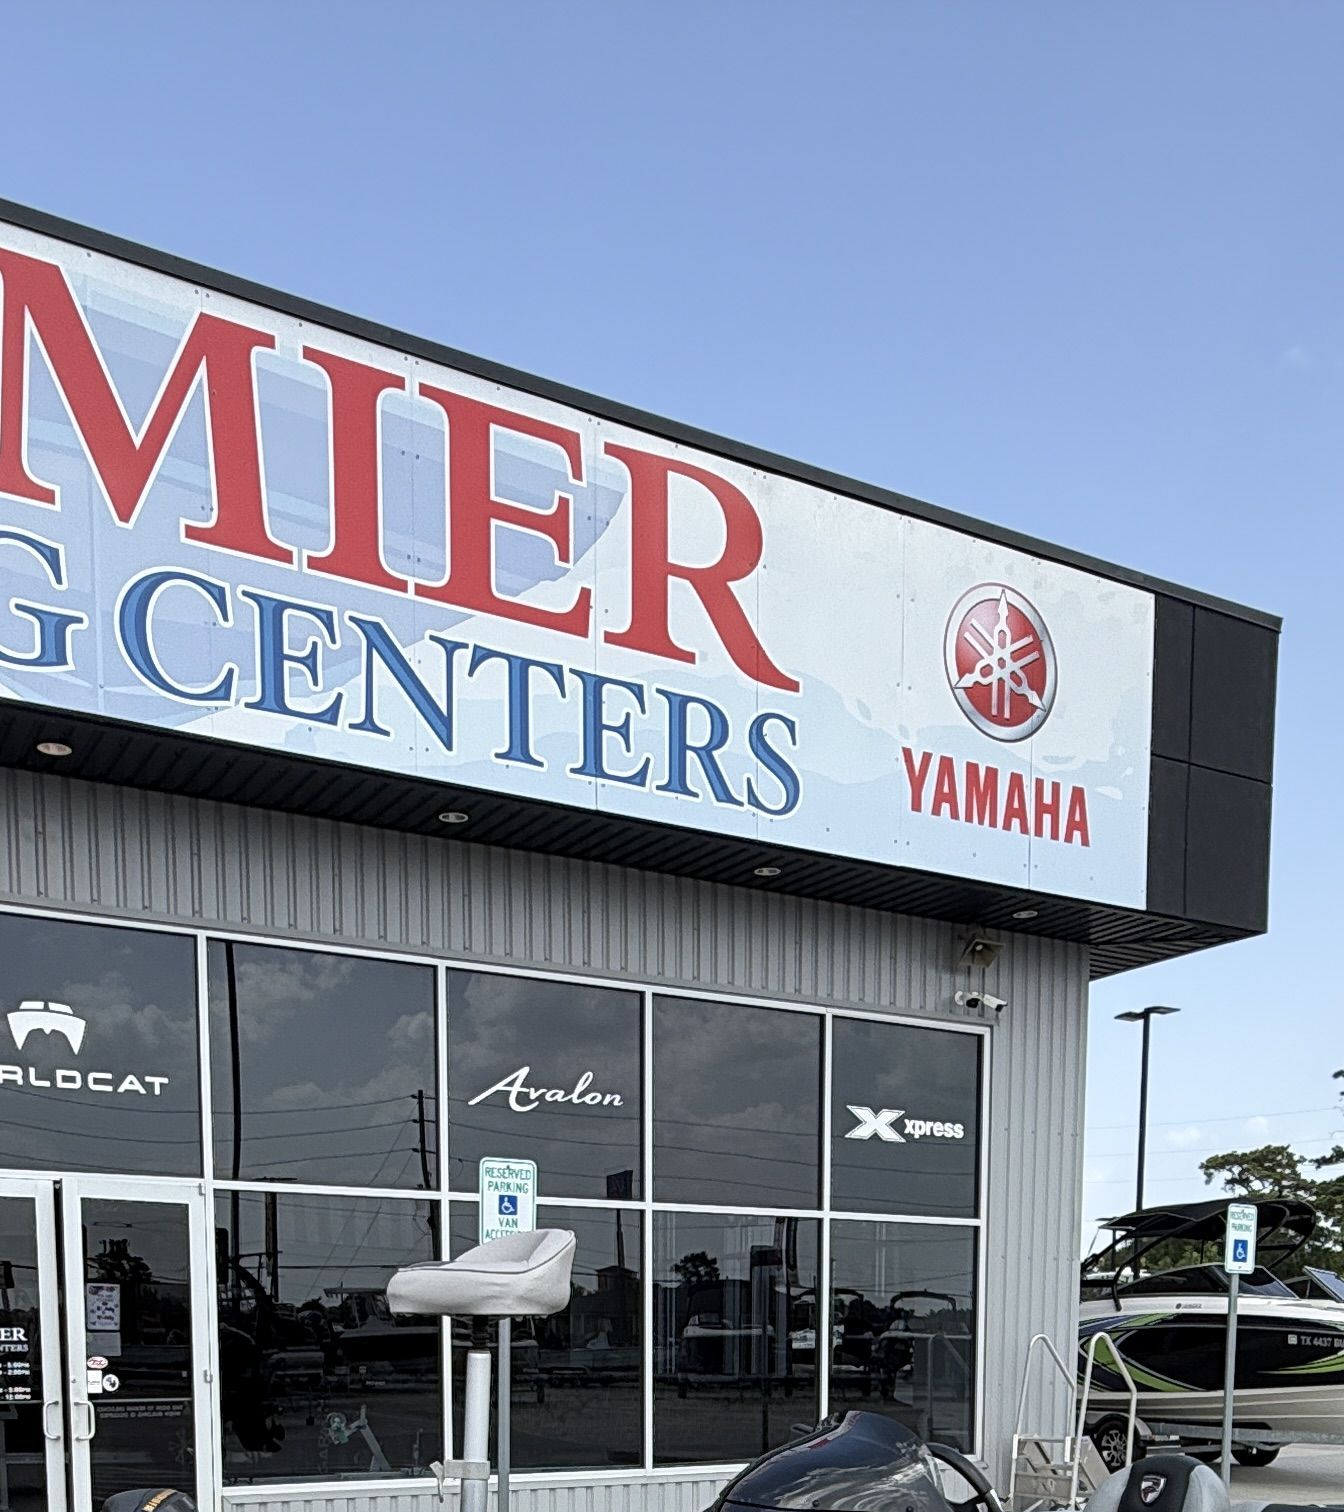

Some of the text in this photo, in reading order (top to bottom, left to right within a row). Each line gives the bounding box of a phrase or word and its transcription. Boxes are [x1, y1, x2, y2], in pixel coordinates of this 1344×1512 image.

[118, 569, 800, 816] CENTERS
[901, 746, 1090, 847] YAMAHA
[467, 1066, 624, 1112] Avalon
[903, 1118, 965, 1139] xpress
[484, 1166, 532, 1181] RESERVED
[487, 1180, 529, 1194] PARKING
[498, 1217, 519, 1229] VAN
